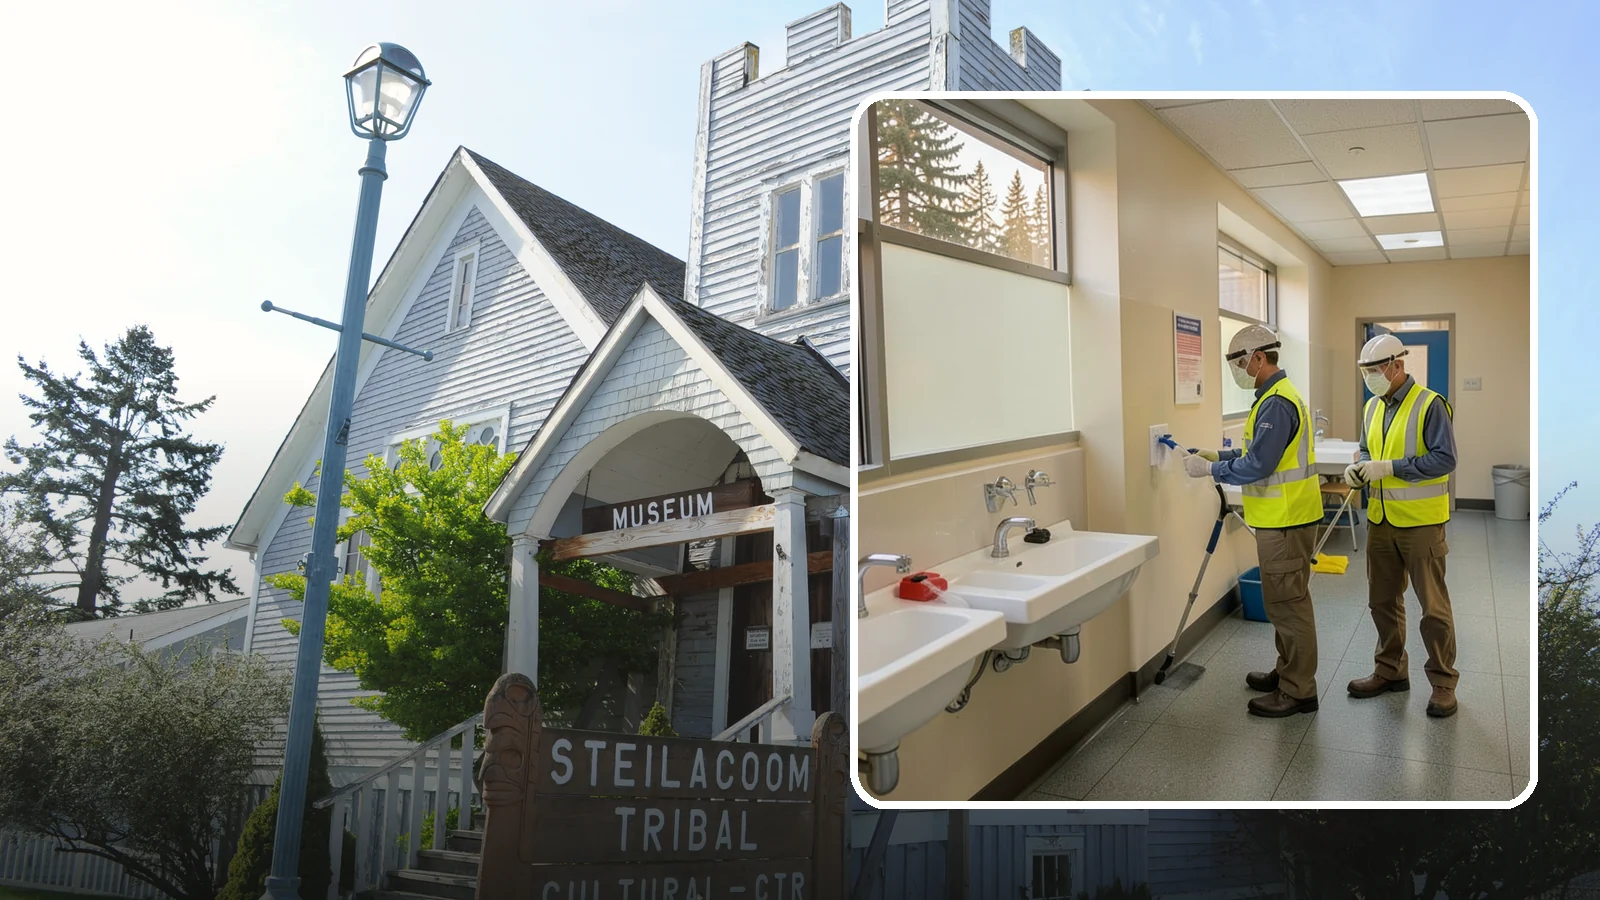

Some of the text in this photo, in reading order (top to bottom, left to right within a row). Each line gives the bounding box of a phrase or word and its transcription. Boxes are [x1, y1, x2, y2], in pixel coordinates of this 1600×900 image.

[612, 491, 714, 531] MUSEUM
[550, 738, 811, 794] STEILACOOM
[614, 806, 758, 852] TRIBAL
